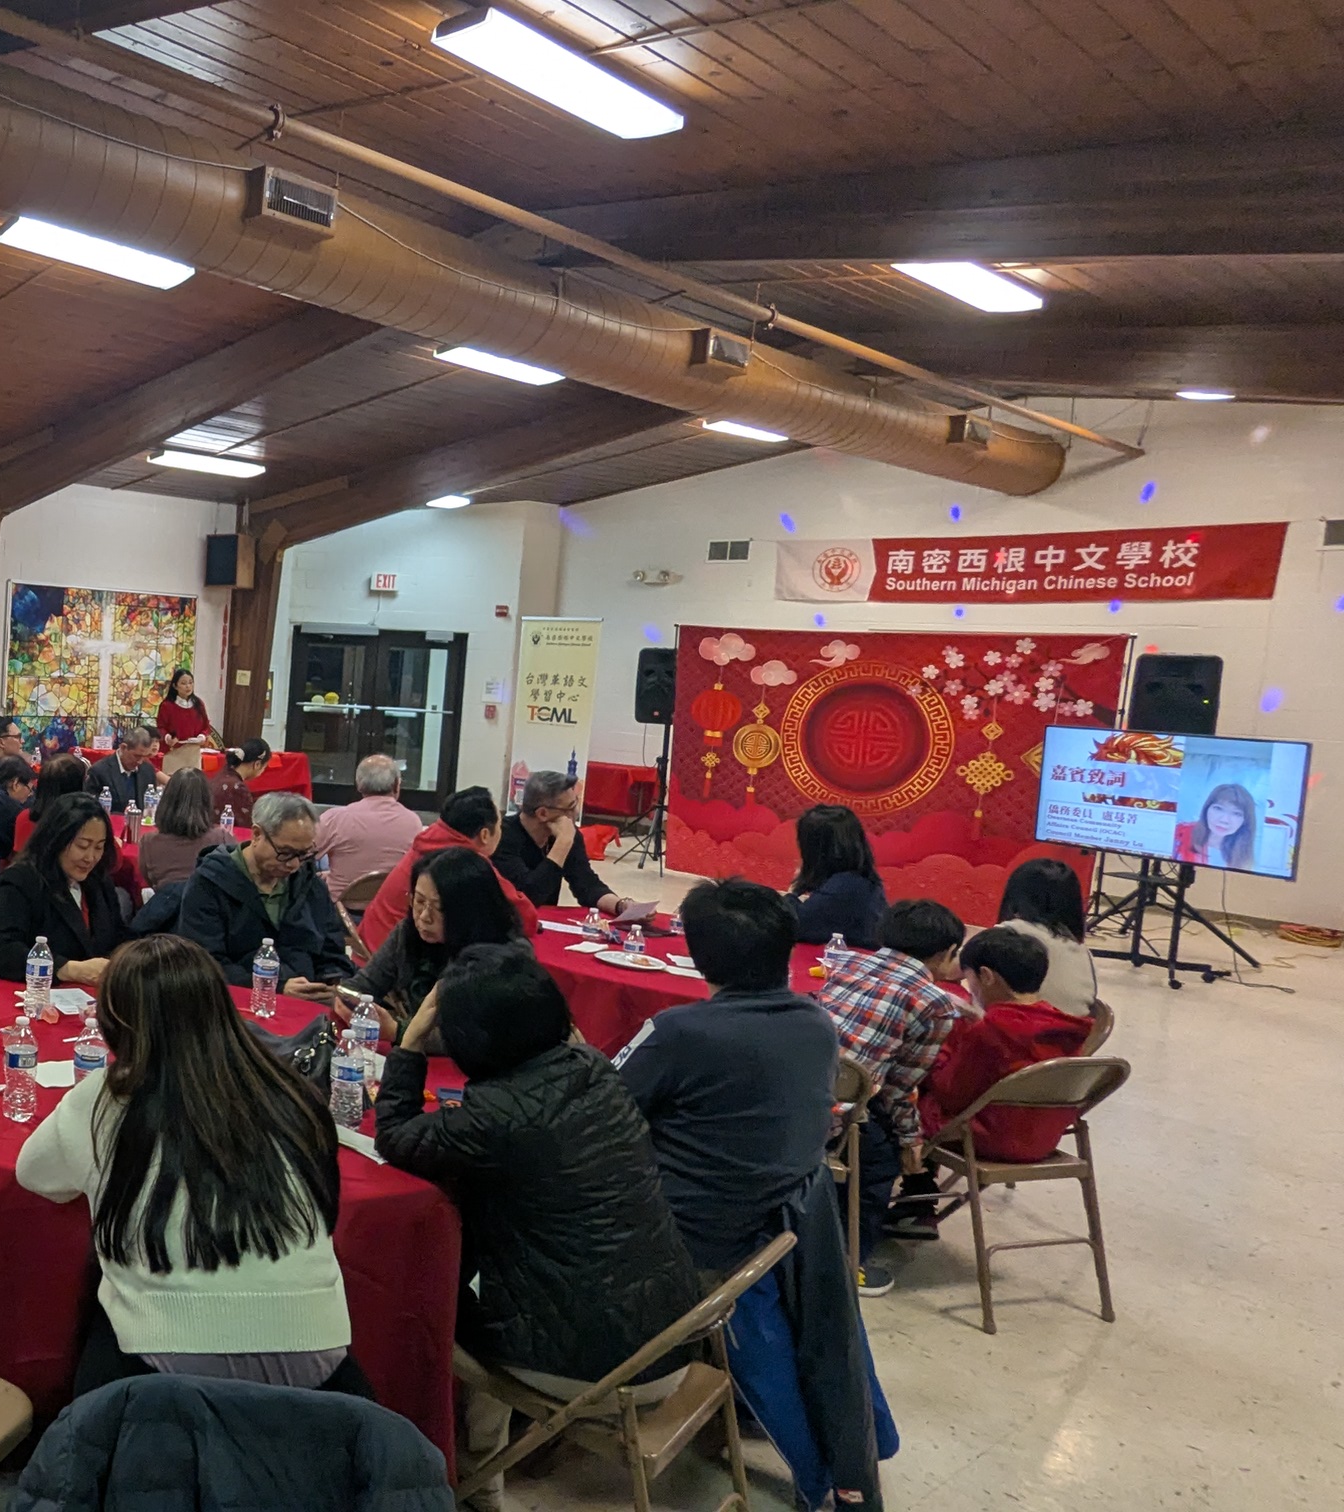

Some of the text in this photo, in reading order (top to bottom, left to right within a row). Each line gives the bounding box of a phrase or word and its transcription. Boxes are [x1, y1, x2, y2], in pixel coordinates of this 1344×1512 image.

[887, 539, 1201, 575] 南密西根中文學校
[376, 574, 396, 588] EXIT
[885, 571, 1194, 594] Southern Michigan Chinese School
[526, 672, 588, 688] 台灣華語文
[530, 688, 579, 702] 學習中心
[527, 705, 577, 724] TCML
[1051, 765, 1126, 787] 嘉賓致詞
